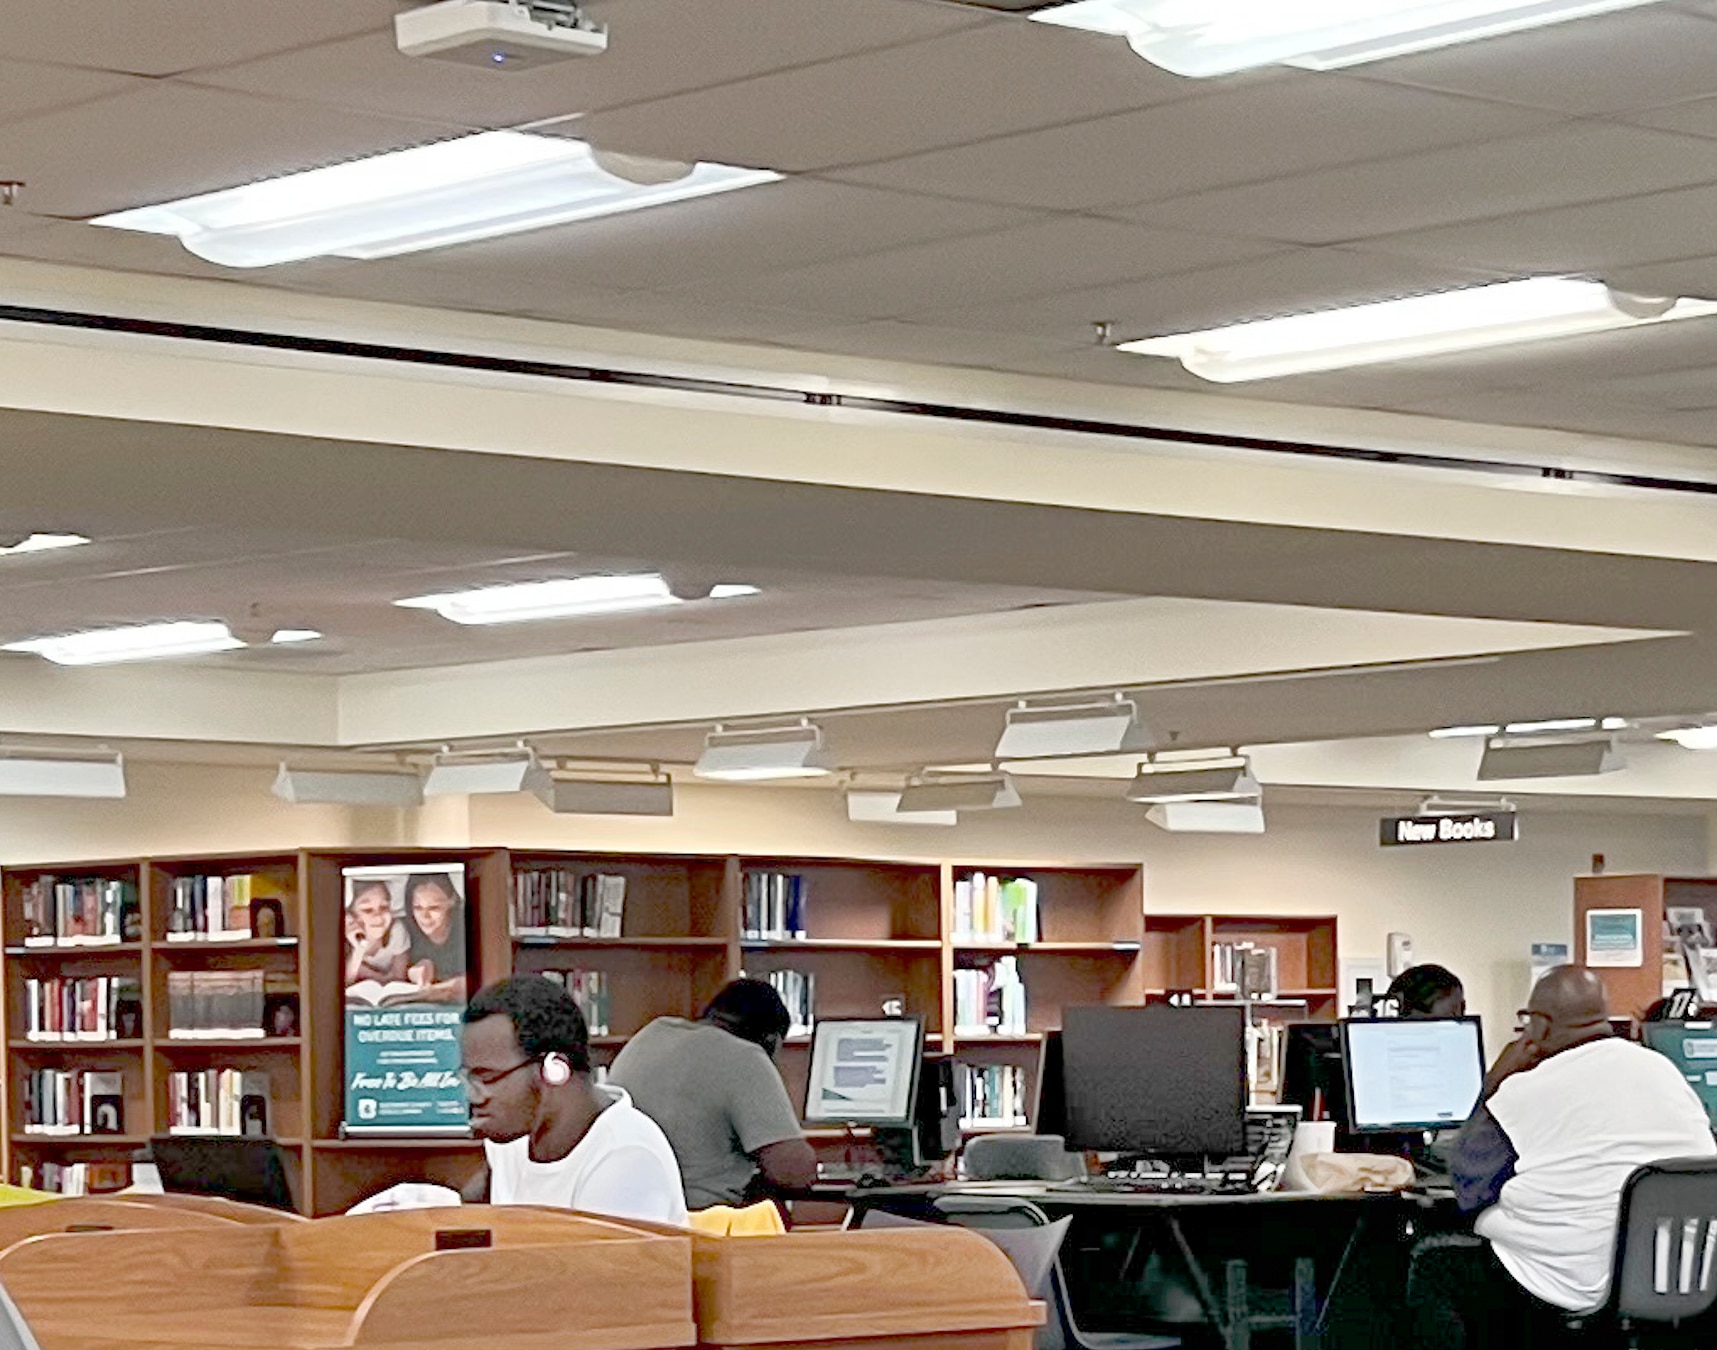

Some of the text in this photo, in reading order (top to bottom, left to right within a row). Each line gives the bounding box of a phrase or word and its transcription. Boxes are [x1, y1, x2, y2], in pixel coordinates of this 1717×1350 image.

[1397, 818, 1495, 841] New Books
[353, 1013, 371, 1026] NO
[374, 1012, 401, 1026] LATE
